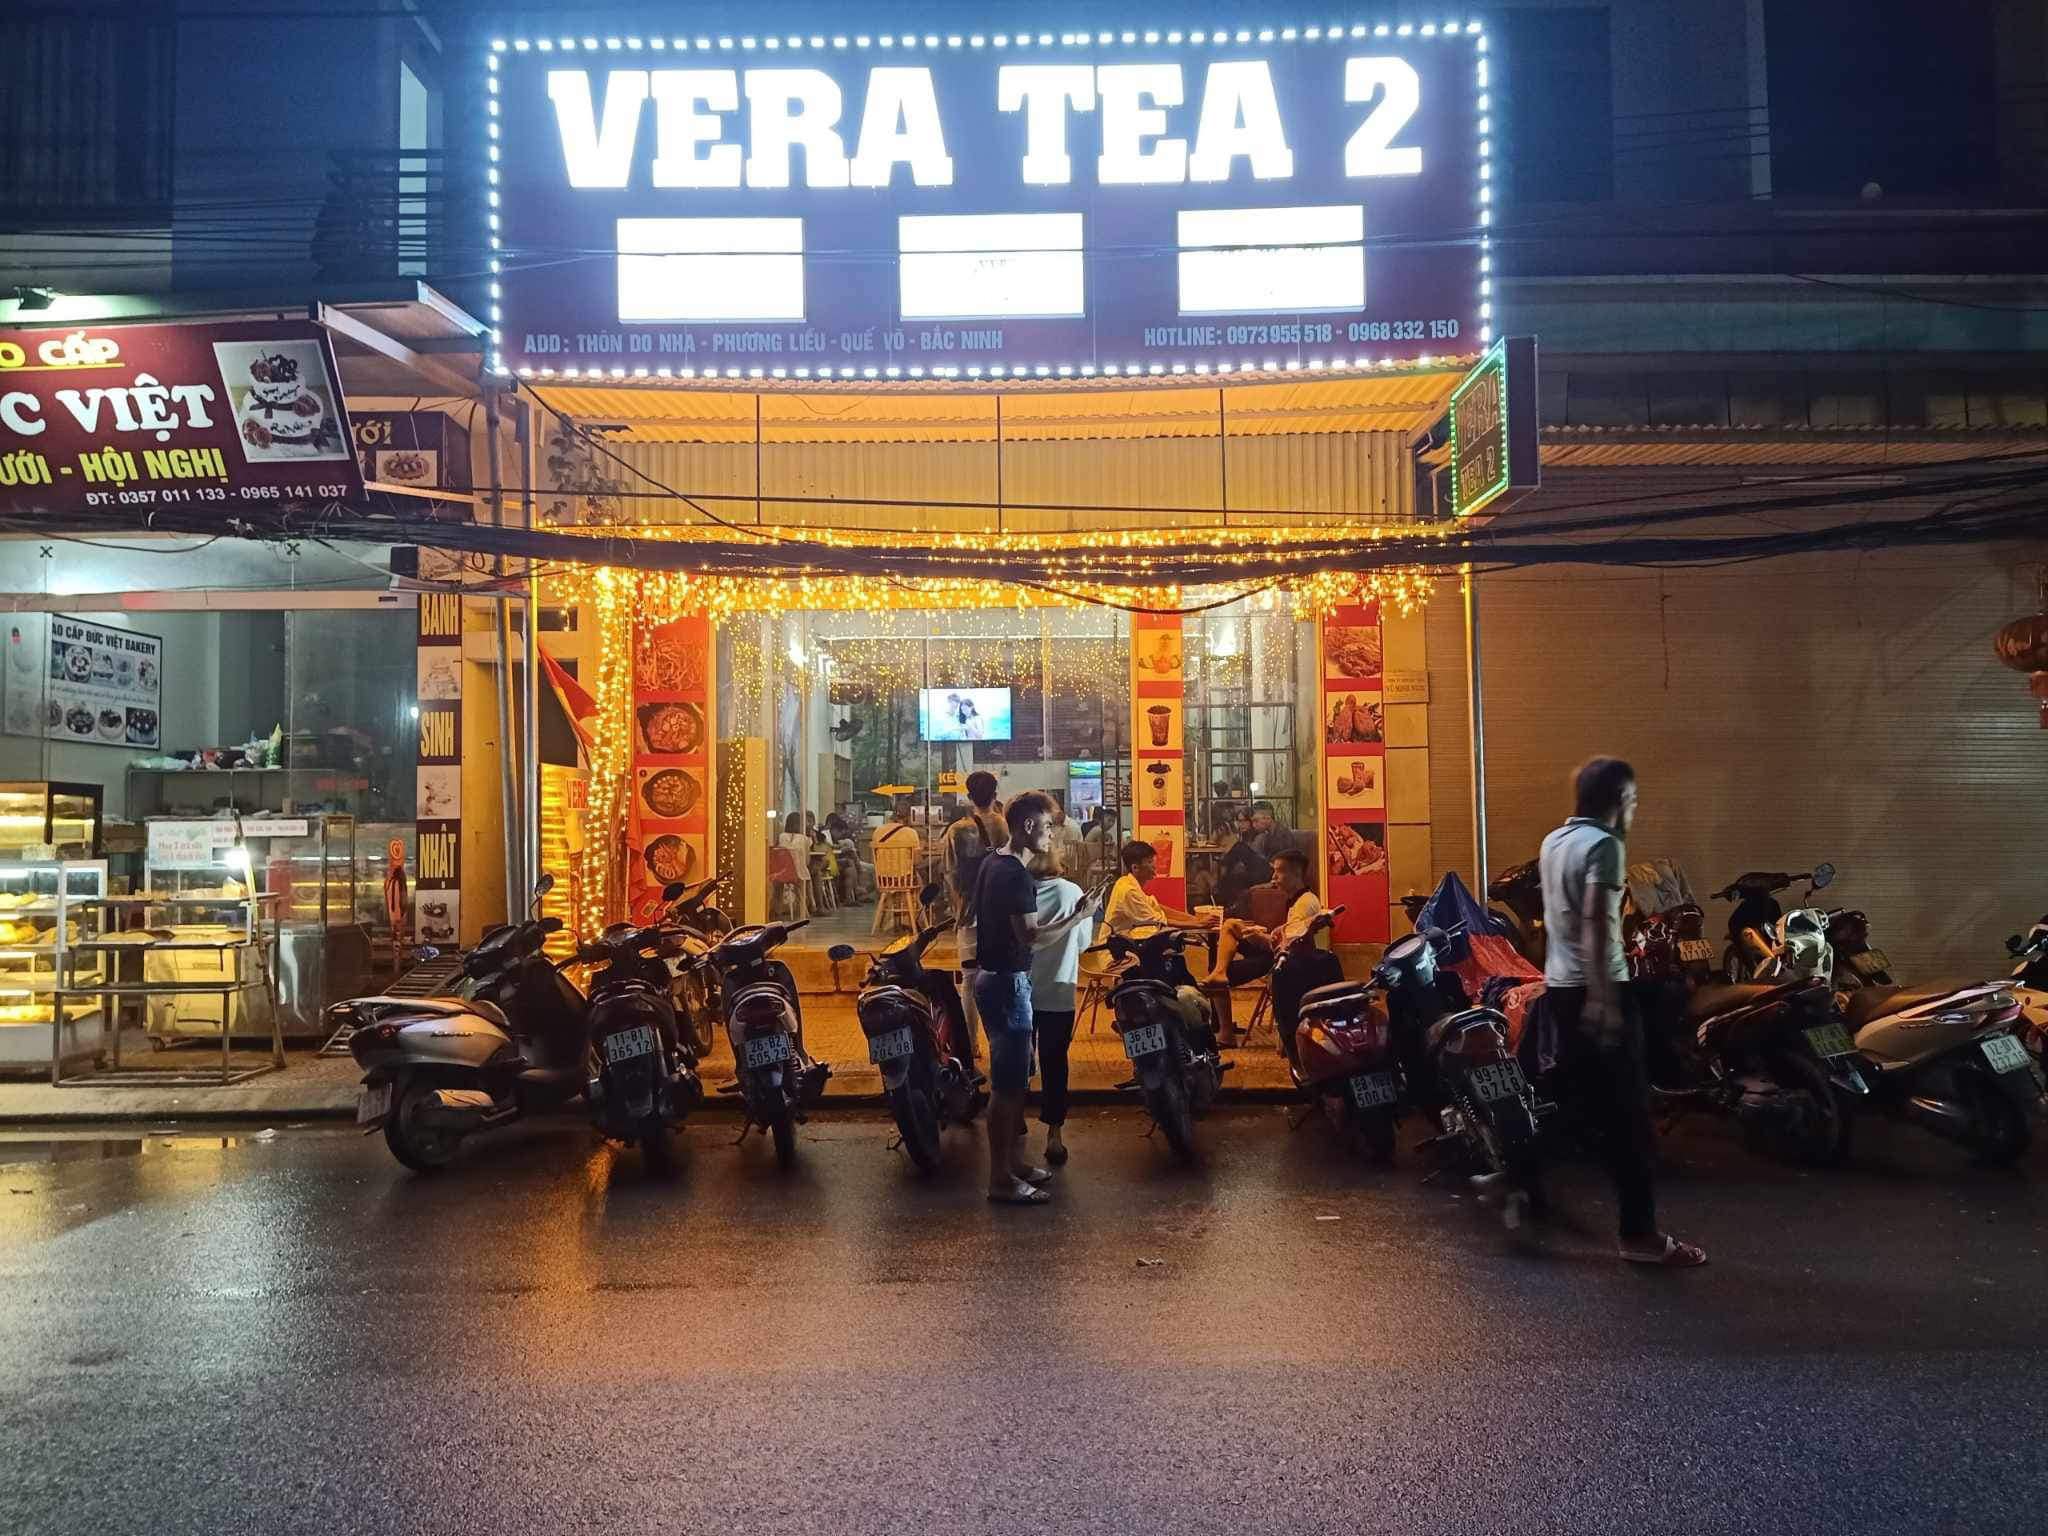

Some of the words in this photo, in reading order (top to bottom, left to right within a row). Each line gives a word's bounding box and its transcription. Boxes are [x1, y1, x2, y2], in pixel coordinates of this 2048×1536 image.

[547, 67, 953, 188] VERA
[998, 60, 1294, 185] TEA
[1345, 56, 1422, 177] 2
[524, 333, 569, 353] ADD:
[576, 330, 623, 353] THÔN
[660, 333, 696, 353] NHA
[841, 326, 875, 353] QUẾ
[920, 325, 954, 351] BẮC
[960, 330, 1003, 350] NINH
[1144, 325, 1222, 346] HOTLINE:
[1429, 319, 1459, 339] 150
[55, 373, 215, 442] VIỆT
[78, 446, 139, 487] HỘI
[143, 448, 229, 484] NGHỊ
[86, 492, 115, 506] ĐT:
[118, 489, 157, 505] 0357
[162, 488, 190, 502] 011
[196, 487, 226, 501] 133
[240, 486, 280, 500] 0965
[284, 485, 313, 498] 141
[318, 484, 348, 498] 037
[125, 639, 156, 656] BAKERY
[421, 711, 454, 757] SINH
[420, 823, 456, 889] NHẬT
